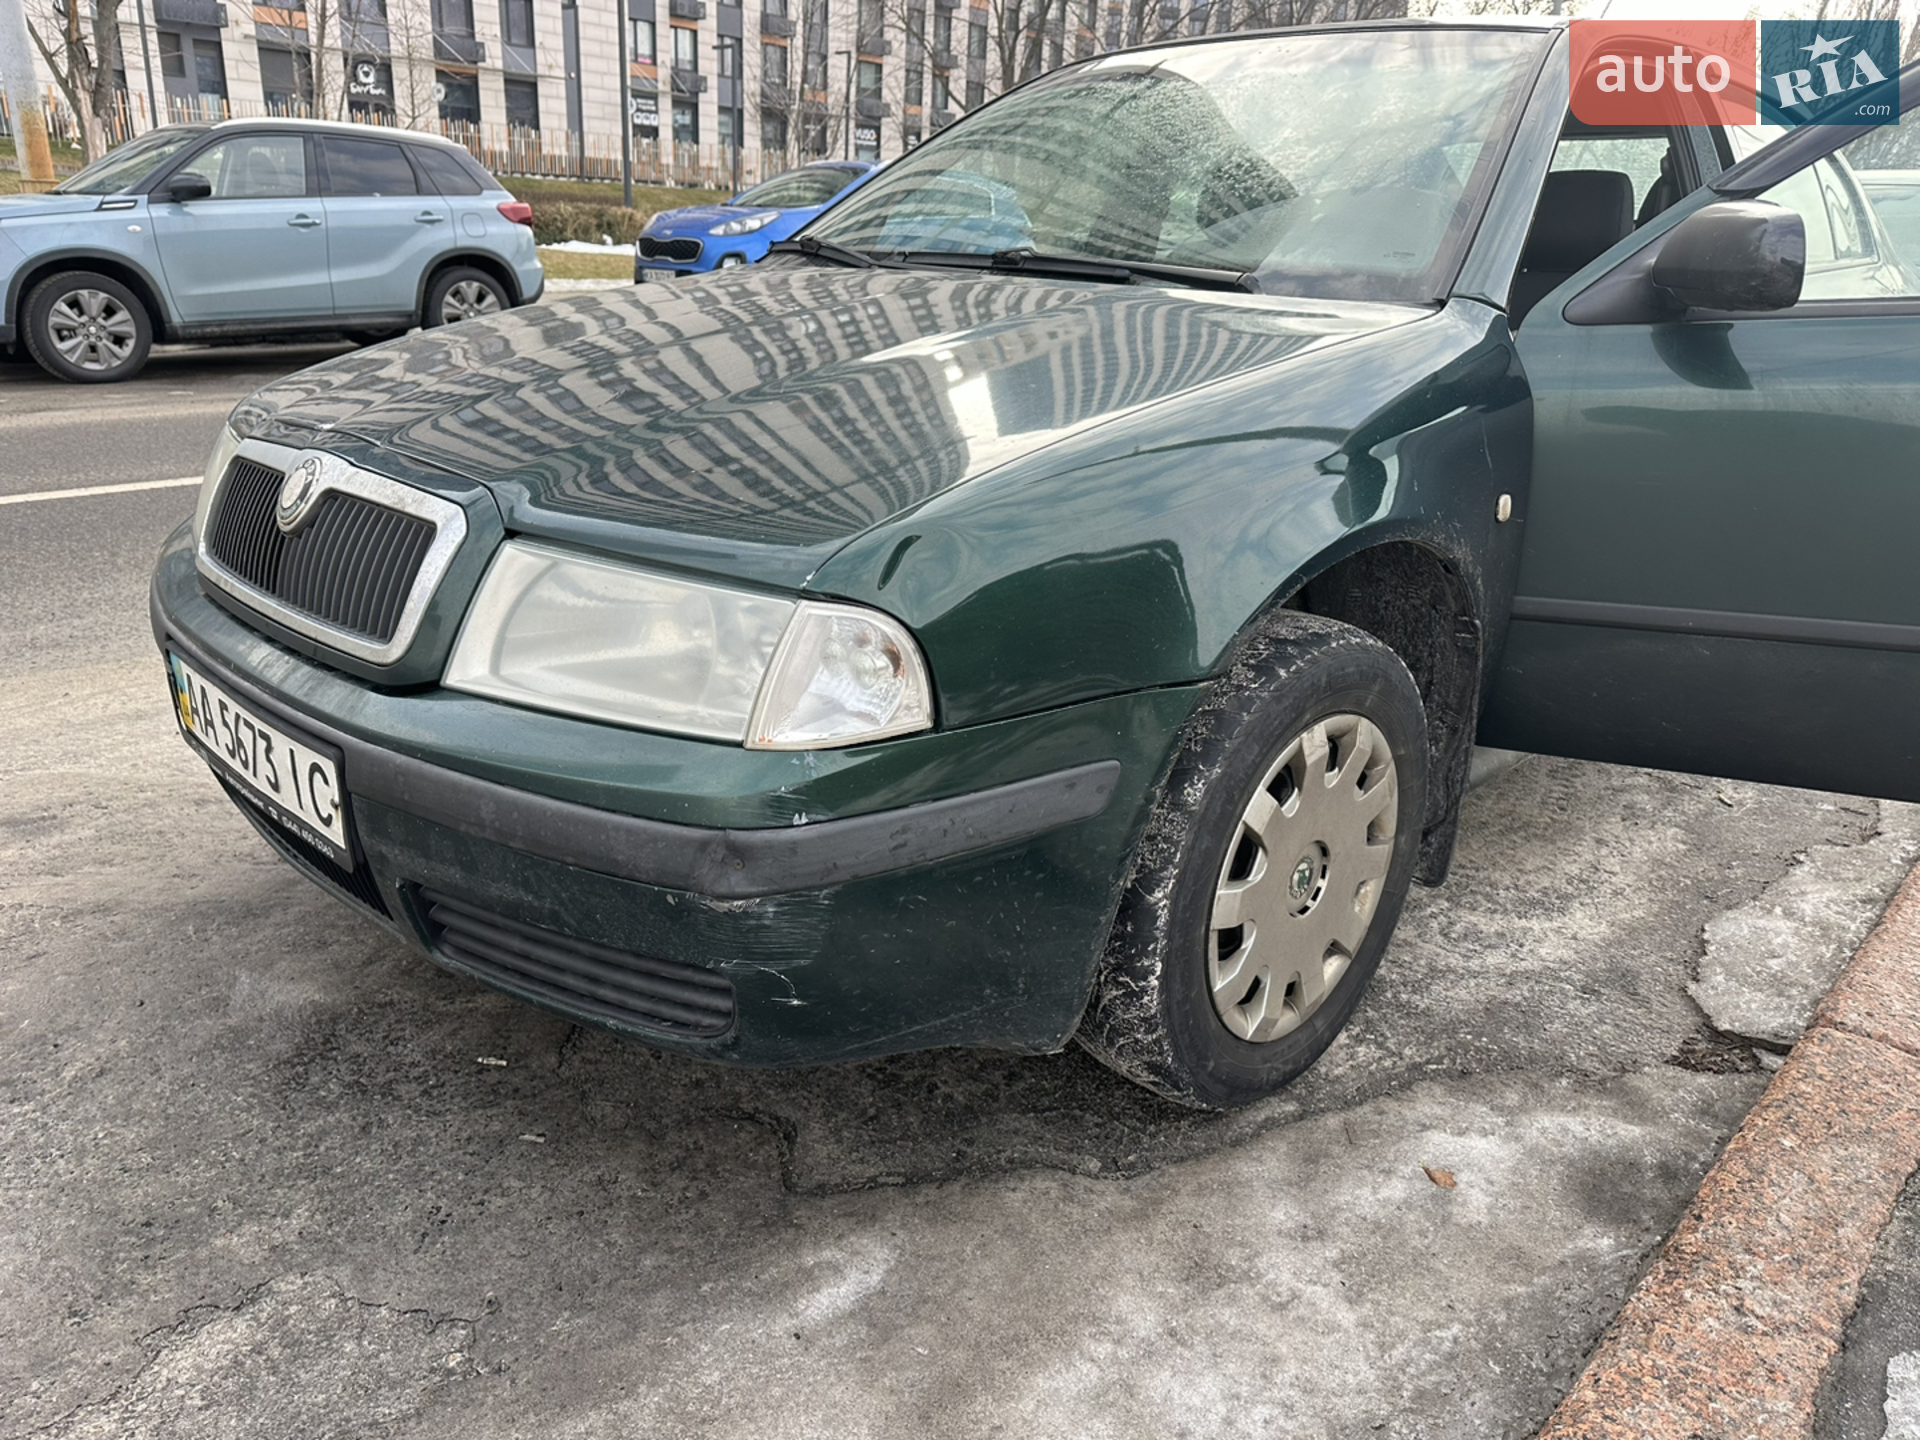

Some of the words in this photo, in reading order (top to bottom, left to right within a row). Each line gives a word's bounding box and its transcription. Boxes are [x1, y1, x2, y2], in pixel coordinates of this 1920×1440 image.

[186, 673, 220, 747] AA
[218, 698, 282, 794] 5673
[289, 748, 333, 828] IC
